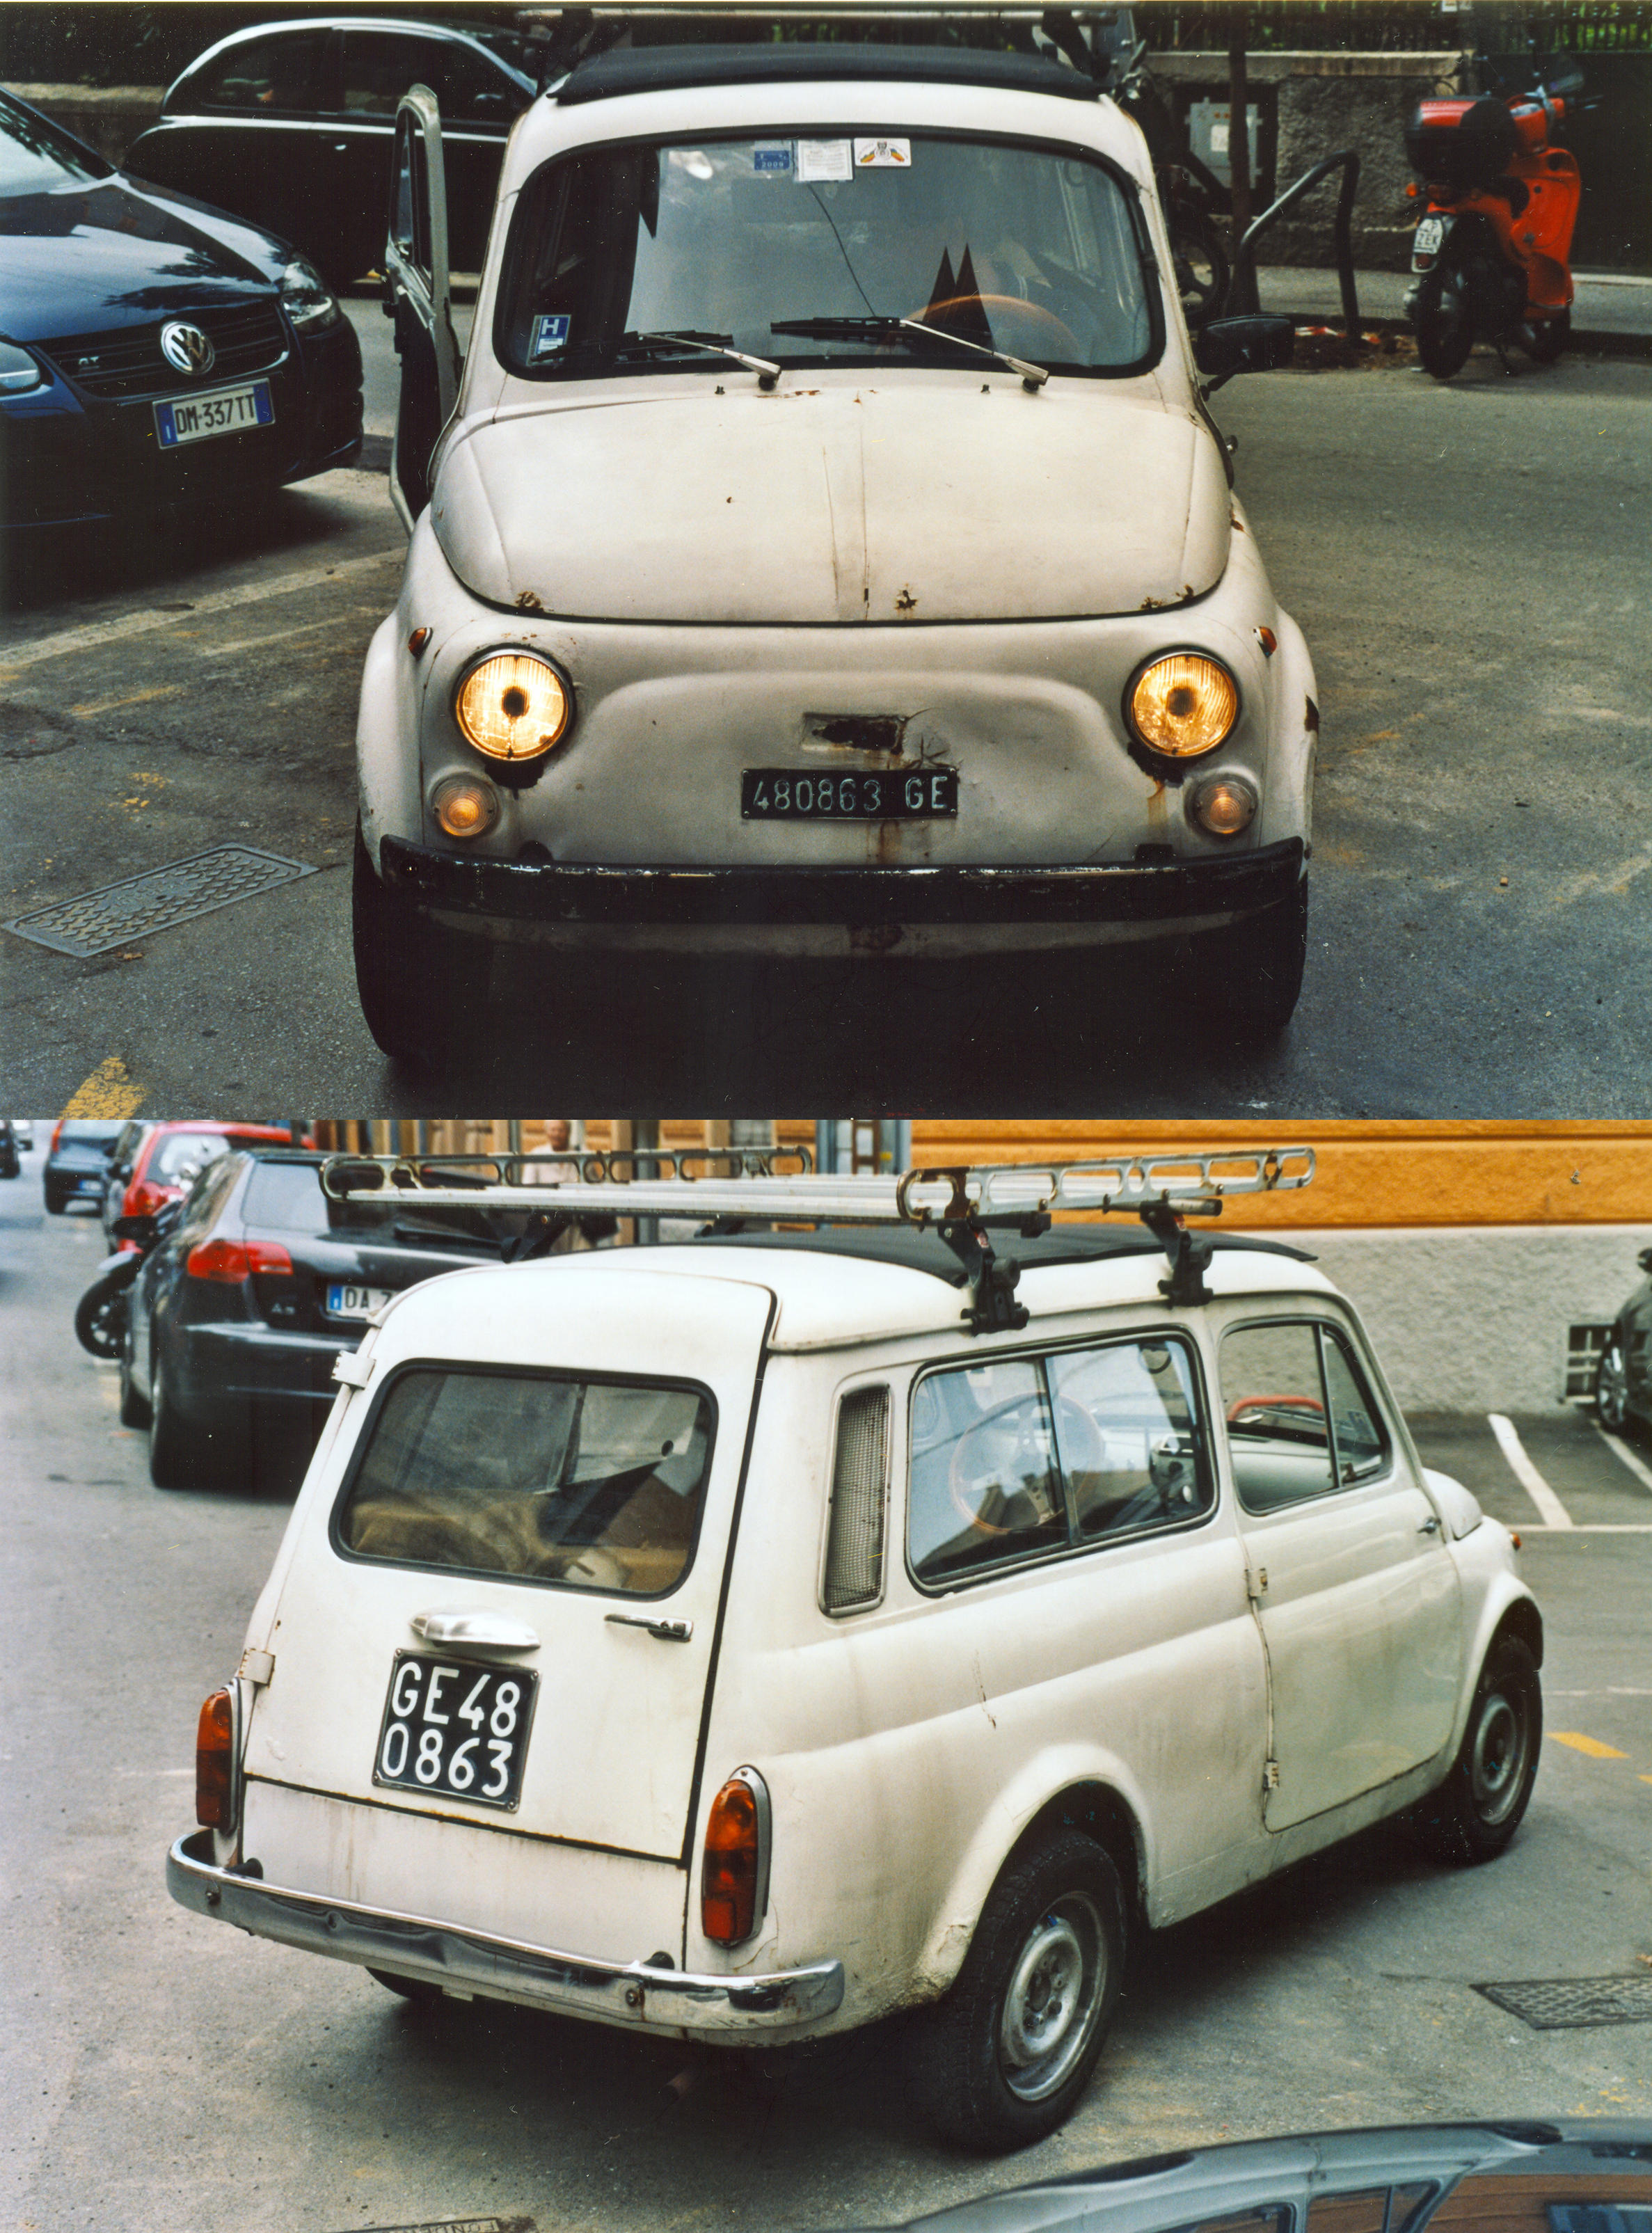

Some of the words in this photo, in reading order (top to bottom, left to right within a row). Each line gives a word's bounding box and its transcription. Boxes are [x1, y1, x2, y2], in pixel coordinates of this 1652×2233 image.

[541, 318, 559, 335] H
[753, 779, 882, 812] 480863
[905, 776, 948, 809] GE
[382, 1722, 514, 1797] 0863
